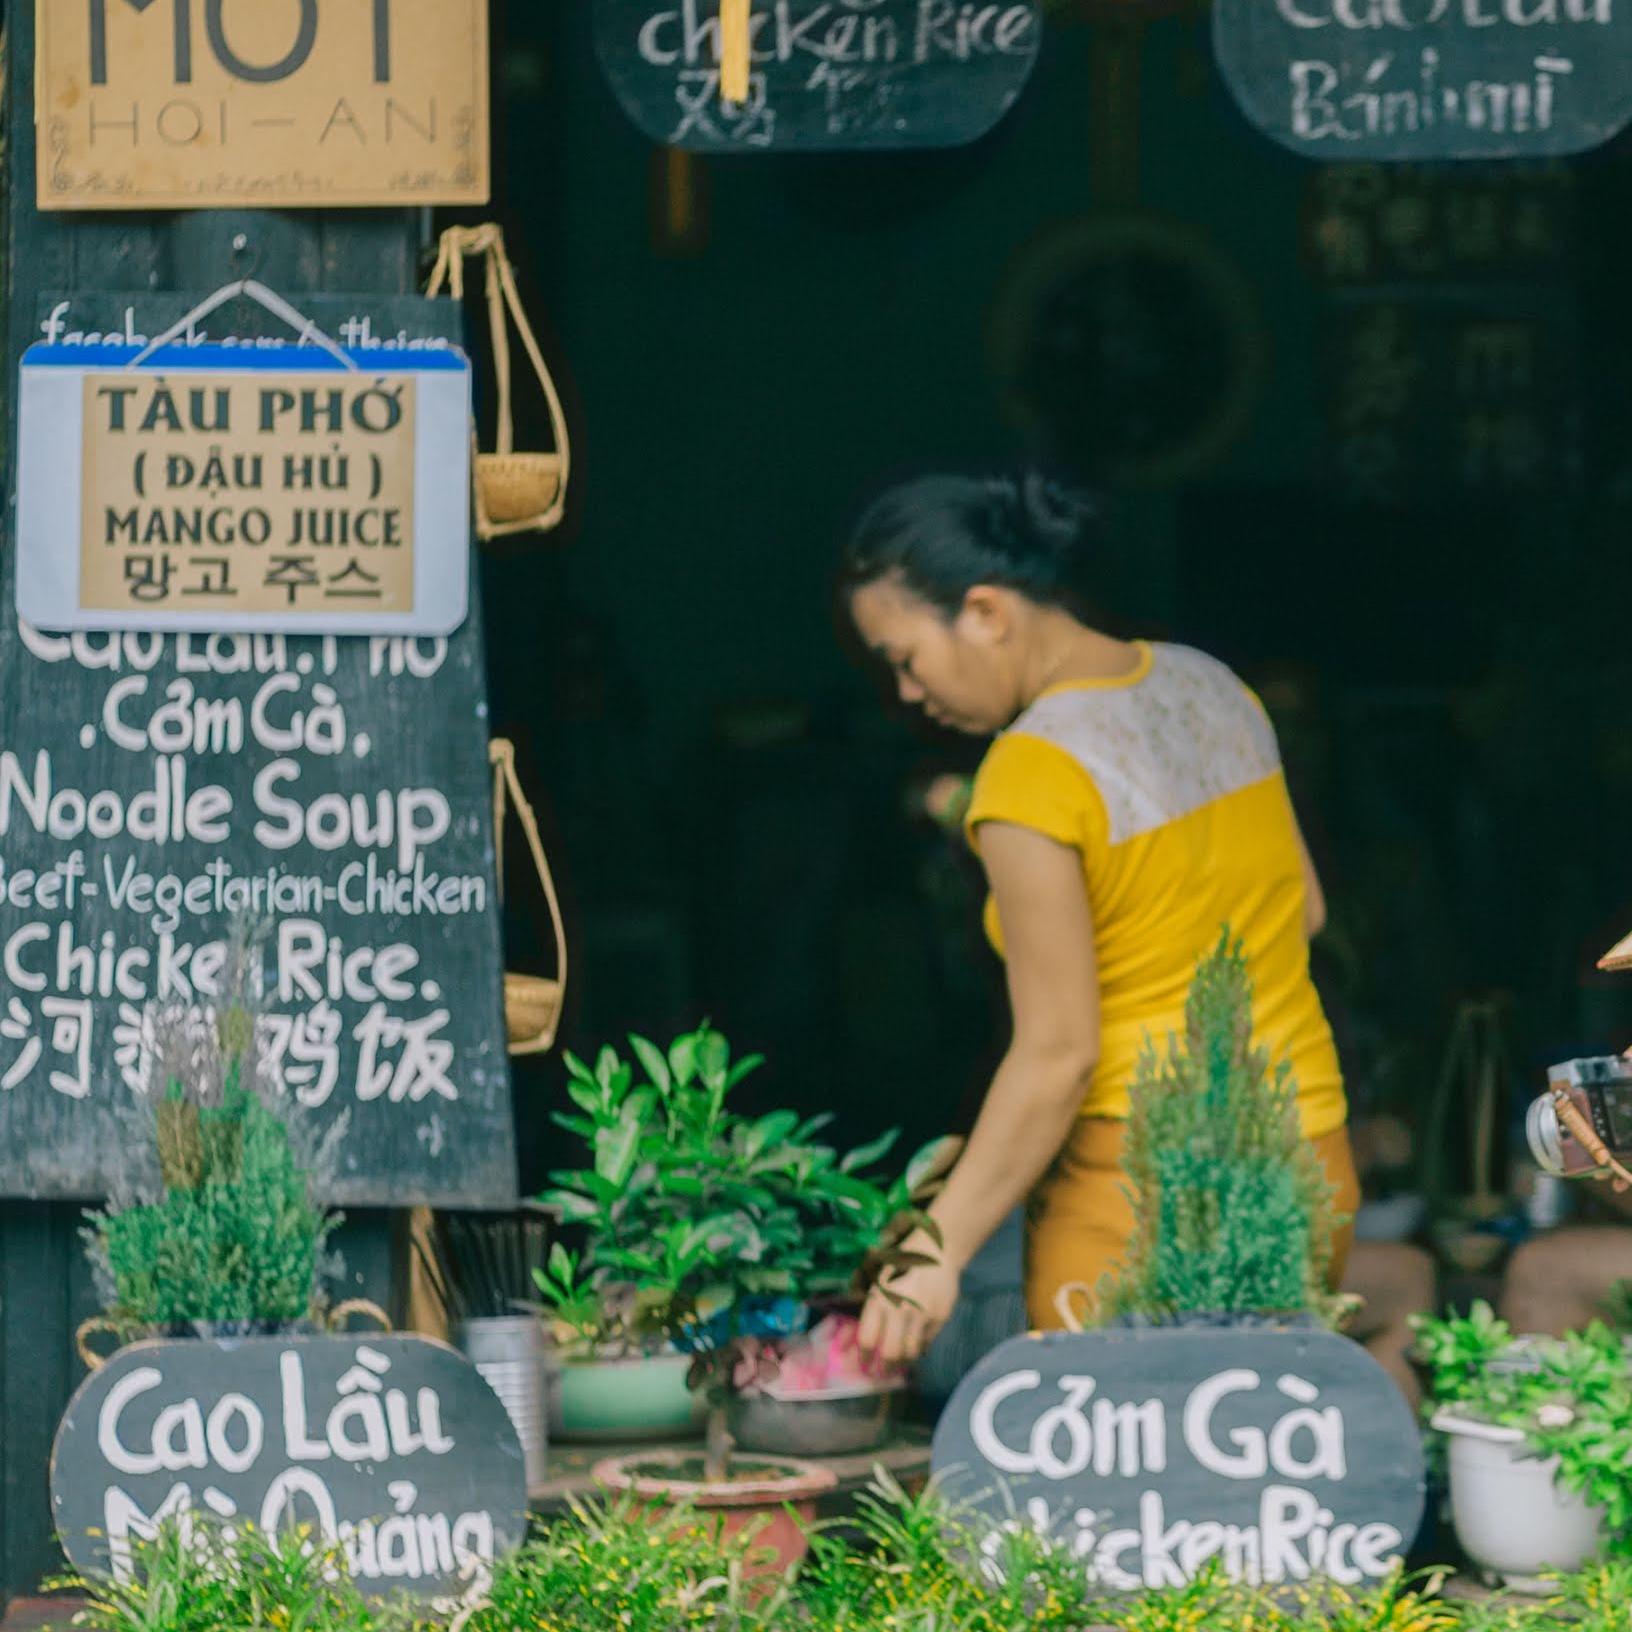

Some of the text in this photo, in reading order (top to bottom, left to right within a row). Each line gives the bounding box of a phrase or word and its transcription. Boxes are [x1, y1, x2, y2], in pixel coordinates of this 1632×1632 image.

[97, 375, 232, 434] TÀU
[104, 506, 403, 548] MANGO JUICE
[124, 553, 383, 605] 망고 주스
[0, 747, 453, 871] Noodle Soup
[98, 1345, 457, 1475] Cao Lầu
[1183, 1368, 1348, 1482] Gà
